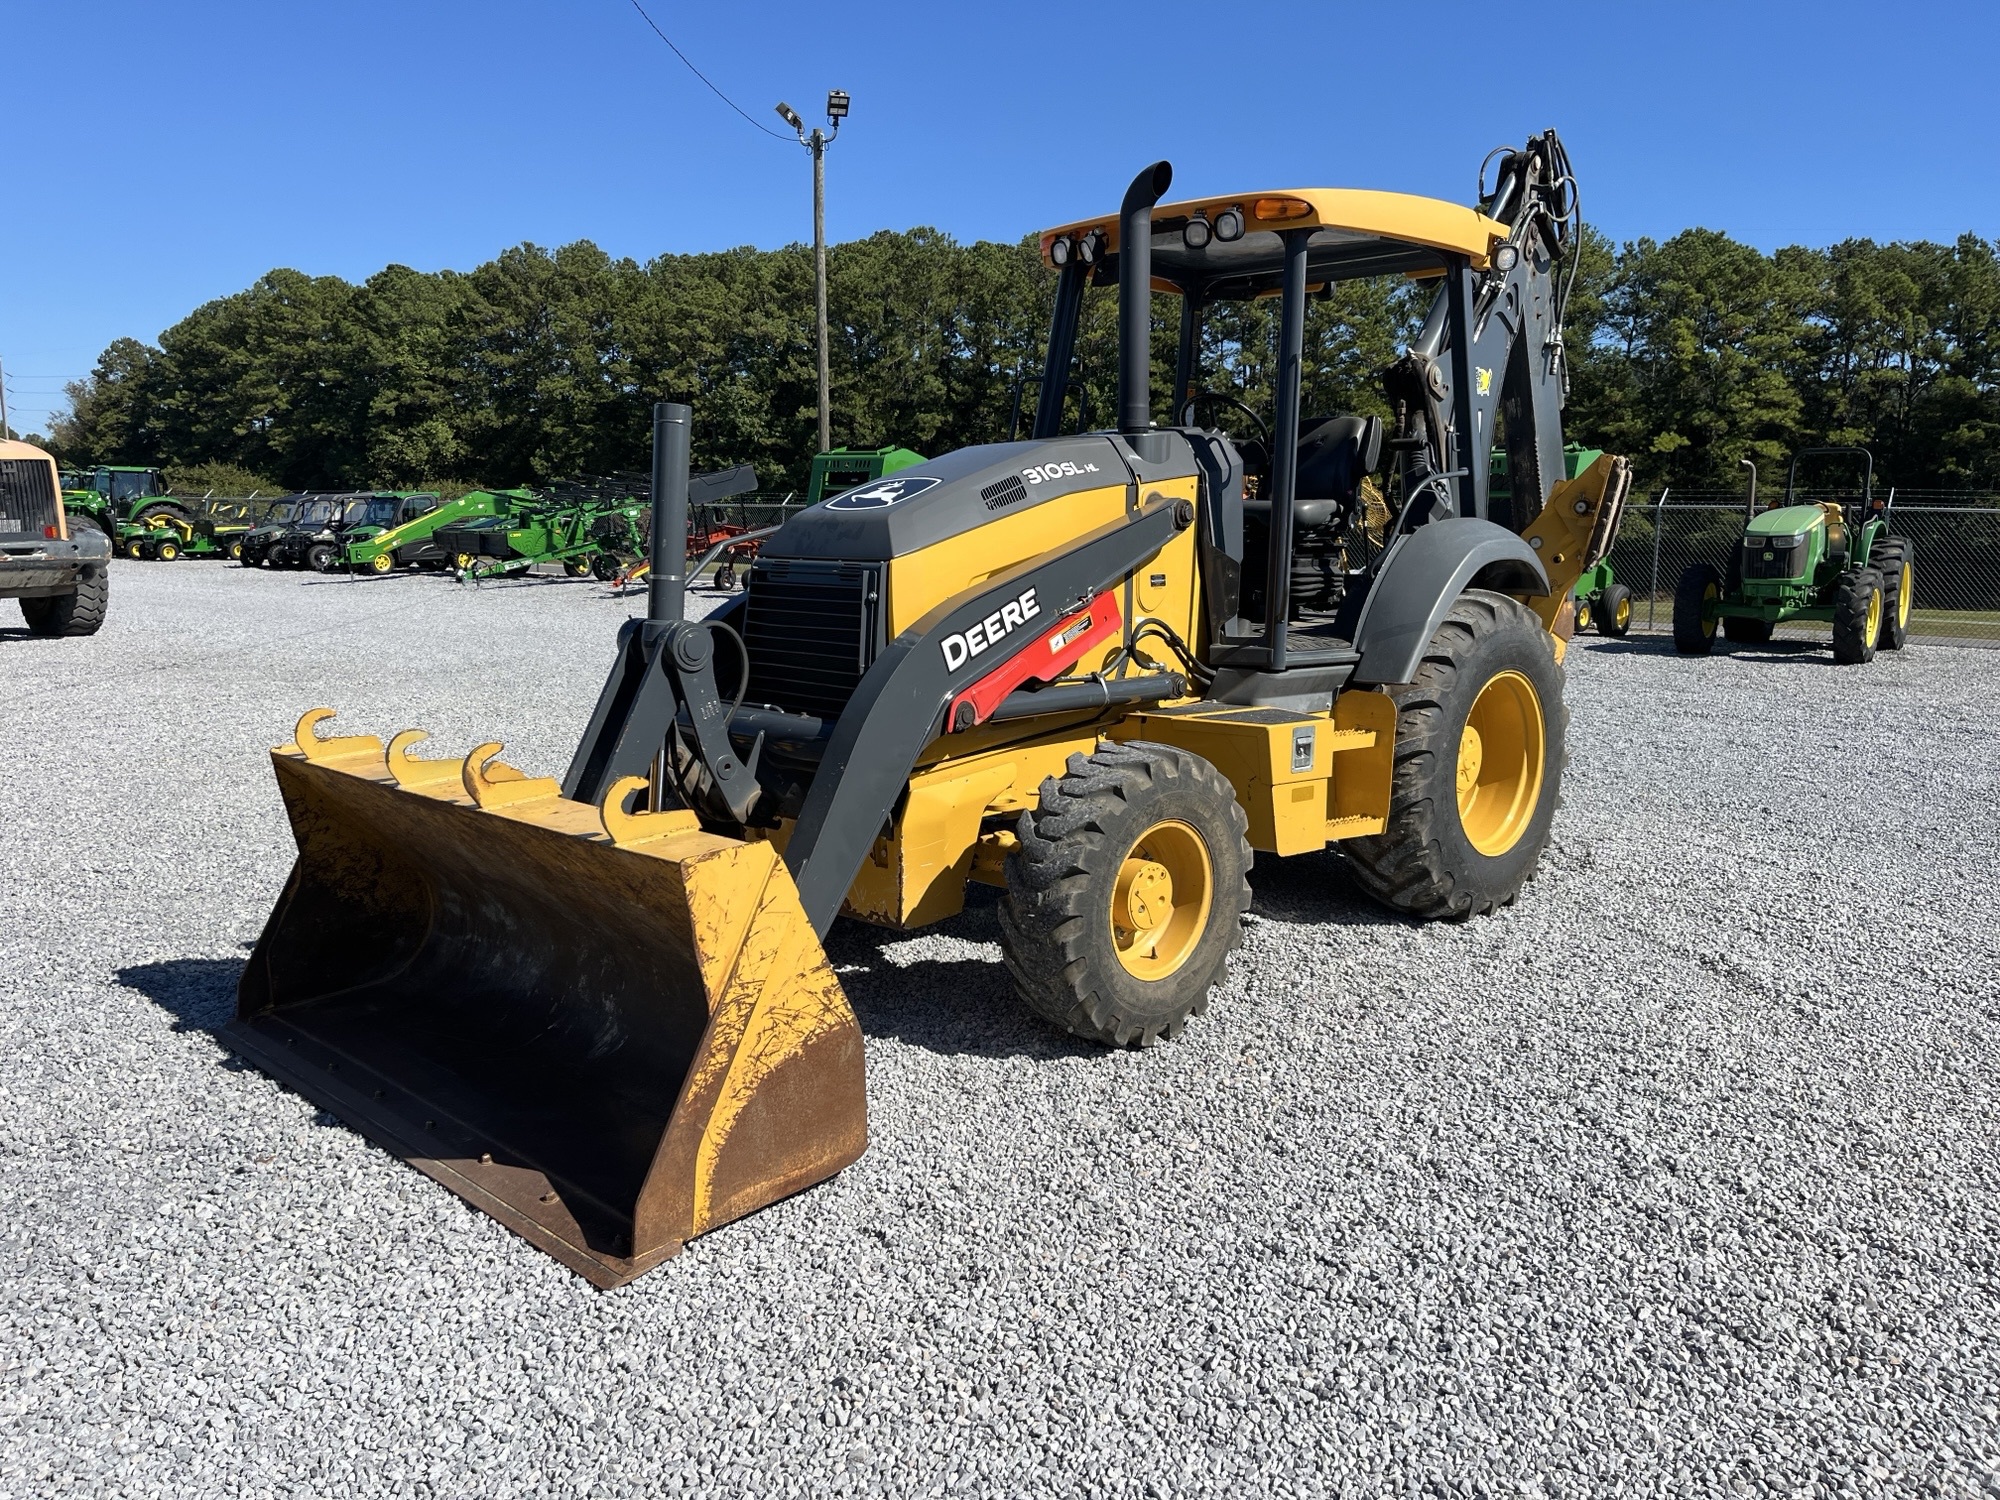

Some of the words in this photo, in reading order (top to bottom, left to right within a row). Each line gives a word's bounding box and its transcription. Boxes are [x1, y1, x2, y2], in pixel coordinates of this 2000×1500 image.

[1022, 461, 1085, 485] 310SL
[1083, 463, 1100, 473] HL
[941, 587, 1040, 671] DEERE
